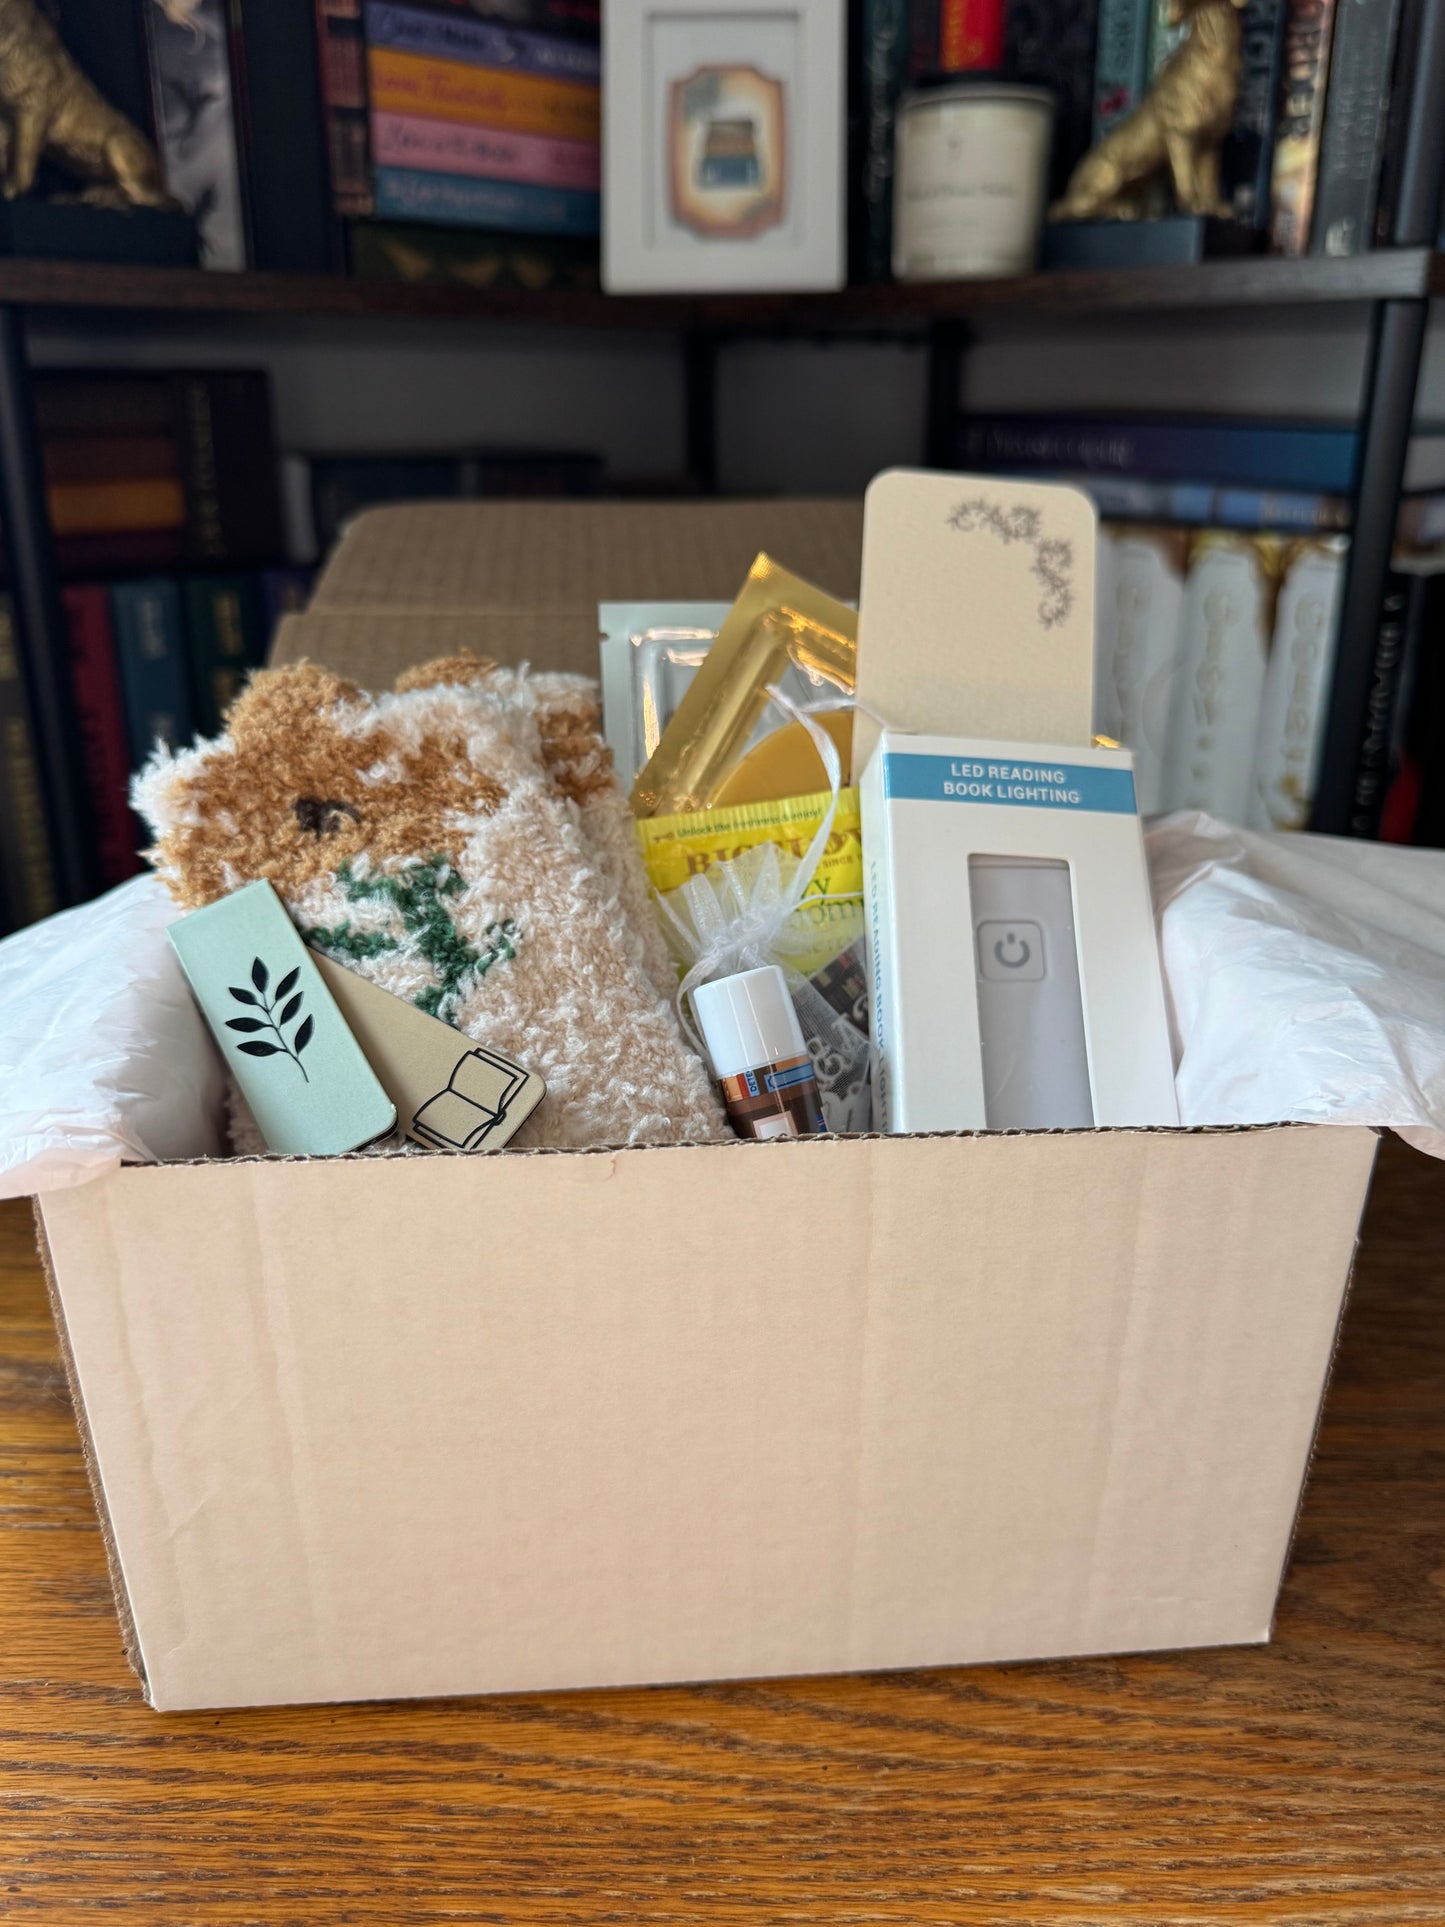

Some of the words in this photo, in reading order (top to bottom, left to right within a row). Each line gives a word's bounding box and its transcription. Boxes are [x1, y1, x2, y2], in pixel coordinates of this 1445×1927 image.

[951, 763, 984, 778] LED
[988, 766, 1065, 784] READING
[944, 782, 993, 798] BOOK
[997, 785, 1081, 804] LIGHTING
